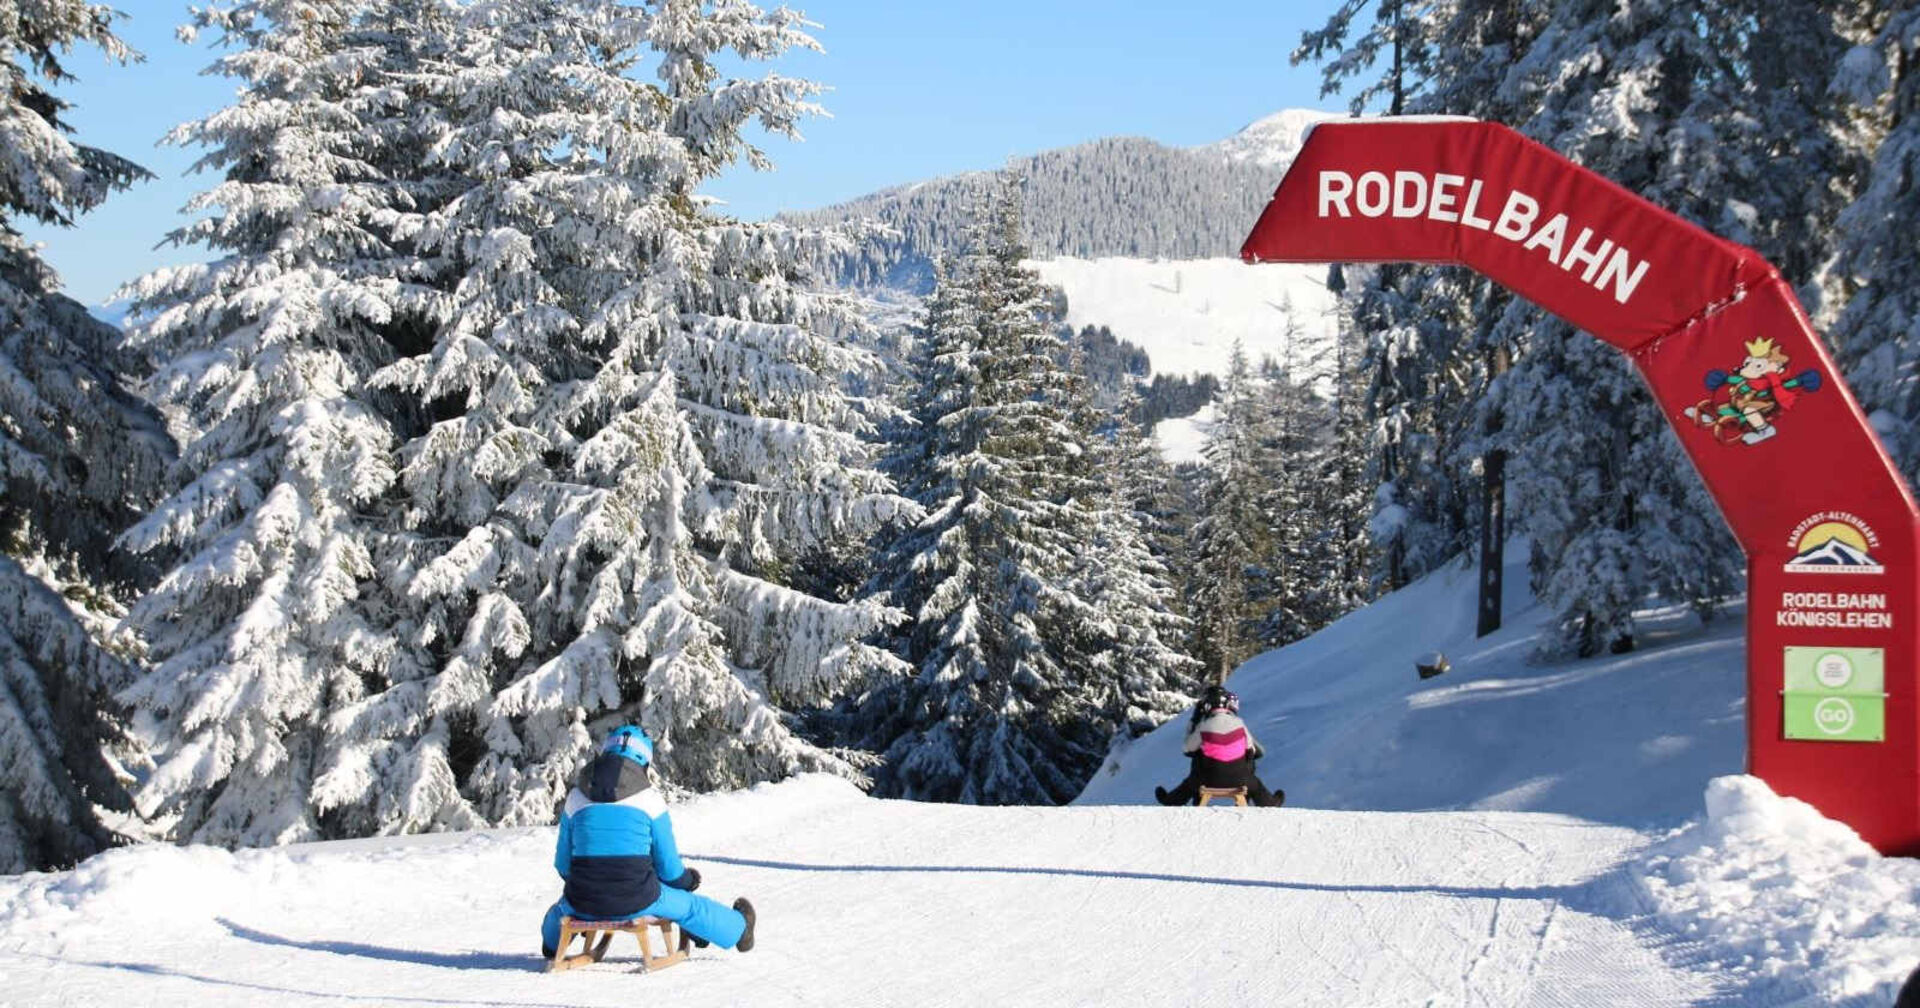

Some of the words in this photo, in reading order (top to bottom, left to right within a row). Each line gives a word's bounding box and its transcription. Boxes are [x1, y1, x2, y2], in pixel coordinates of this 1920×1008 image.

[1318, 170, 1650, 304] RODELBAHN
[1783, 593, 1885, 609] RODELBAHN
[1777, 608, 1892, 628] KÖNIGSLEHEN
[1821, 709, 1847, 722] GO
